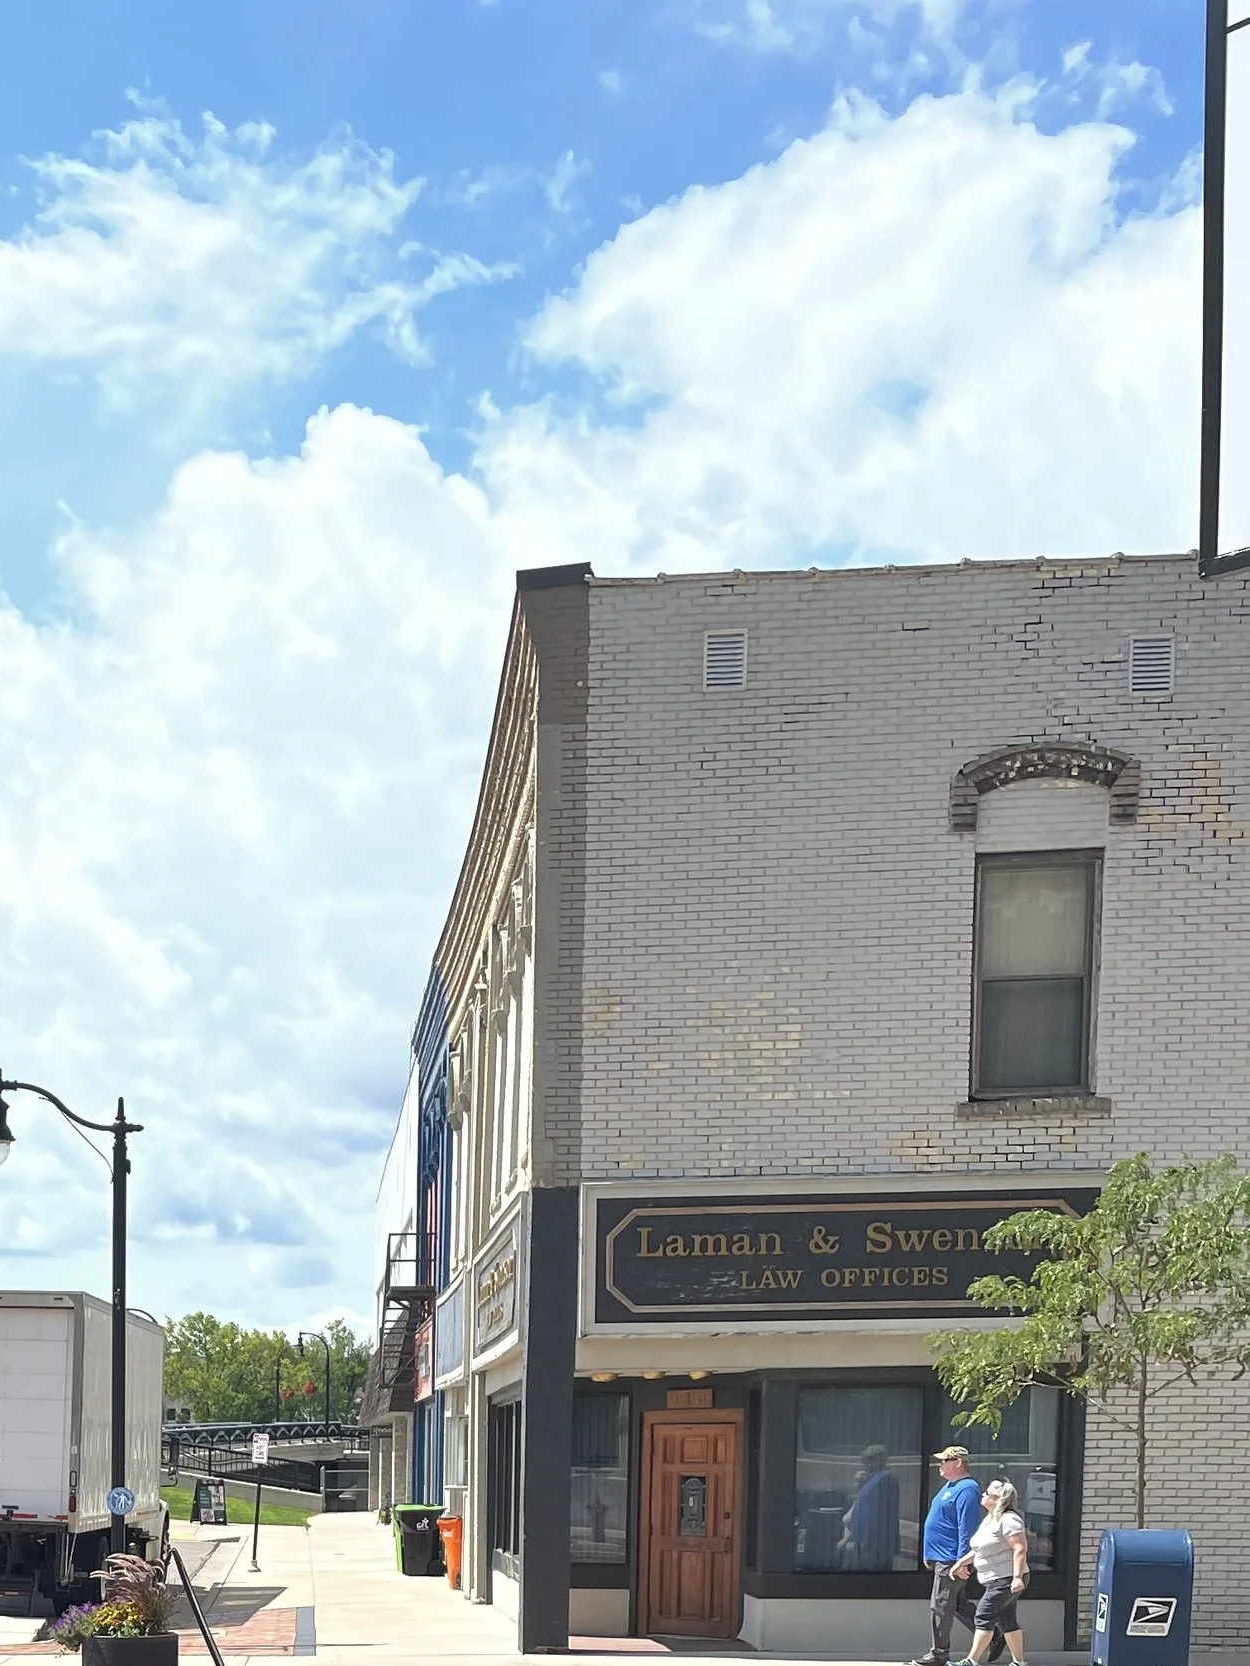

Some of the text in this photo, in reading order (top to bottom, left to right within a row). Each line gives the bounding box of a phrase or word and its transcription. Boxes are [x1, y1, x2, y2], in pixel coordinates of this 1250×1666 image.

[636, 1226, 784, 1257] Laman
[808, 1225, 840, 1254] &
[738, 1266, 949, 1290] LAW OFFICES
